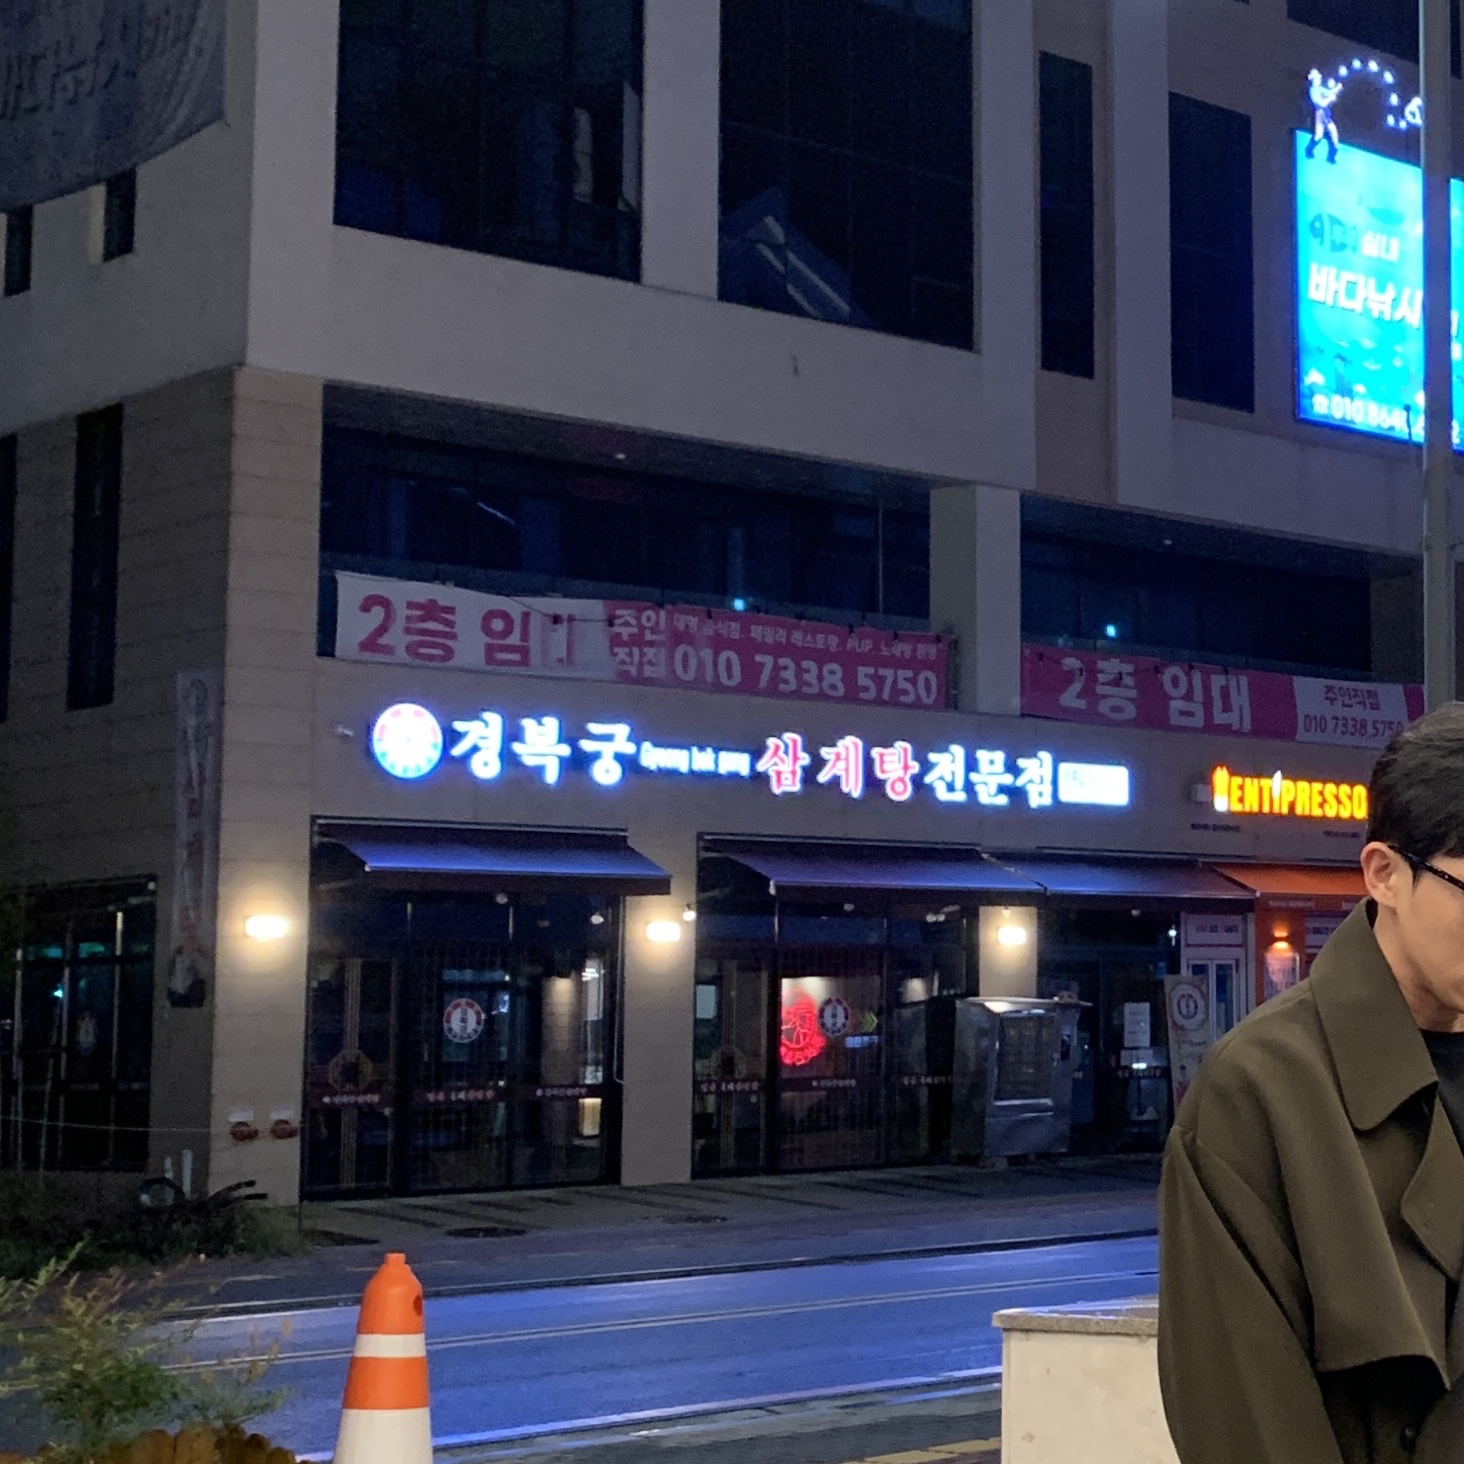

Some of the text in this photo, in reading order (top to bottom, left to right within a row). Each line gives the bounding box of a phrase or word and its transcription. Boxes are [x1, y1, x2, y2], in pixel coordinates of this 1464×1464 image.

[1361, 231, 1399, 263] 실내
[1308, 262, 1459, 338] 바다낚시
[1331, 394, 1364, 424] 010
[358, 593, 458, 663] 2층
[612, 608, 666, 641] 주인
[613, 646, 666, 678] 직접
[674, 644, 938, 705] 010 7338 5750
[1060, 657, 1250, 733] 2층 임대
[1324, 685, 1380, 711] 주인직접
[1303, 714, 1328, 733] 010
[1331, 716, 1368, 737] 7338
[450, 711, 638, 785] 경복궁
[756, 732, 919, 801] 삼계탕
[923, 744, 1053, 808] 전문점
